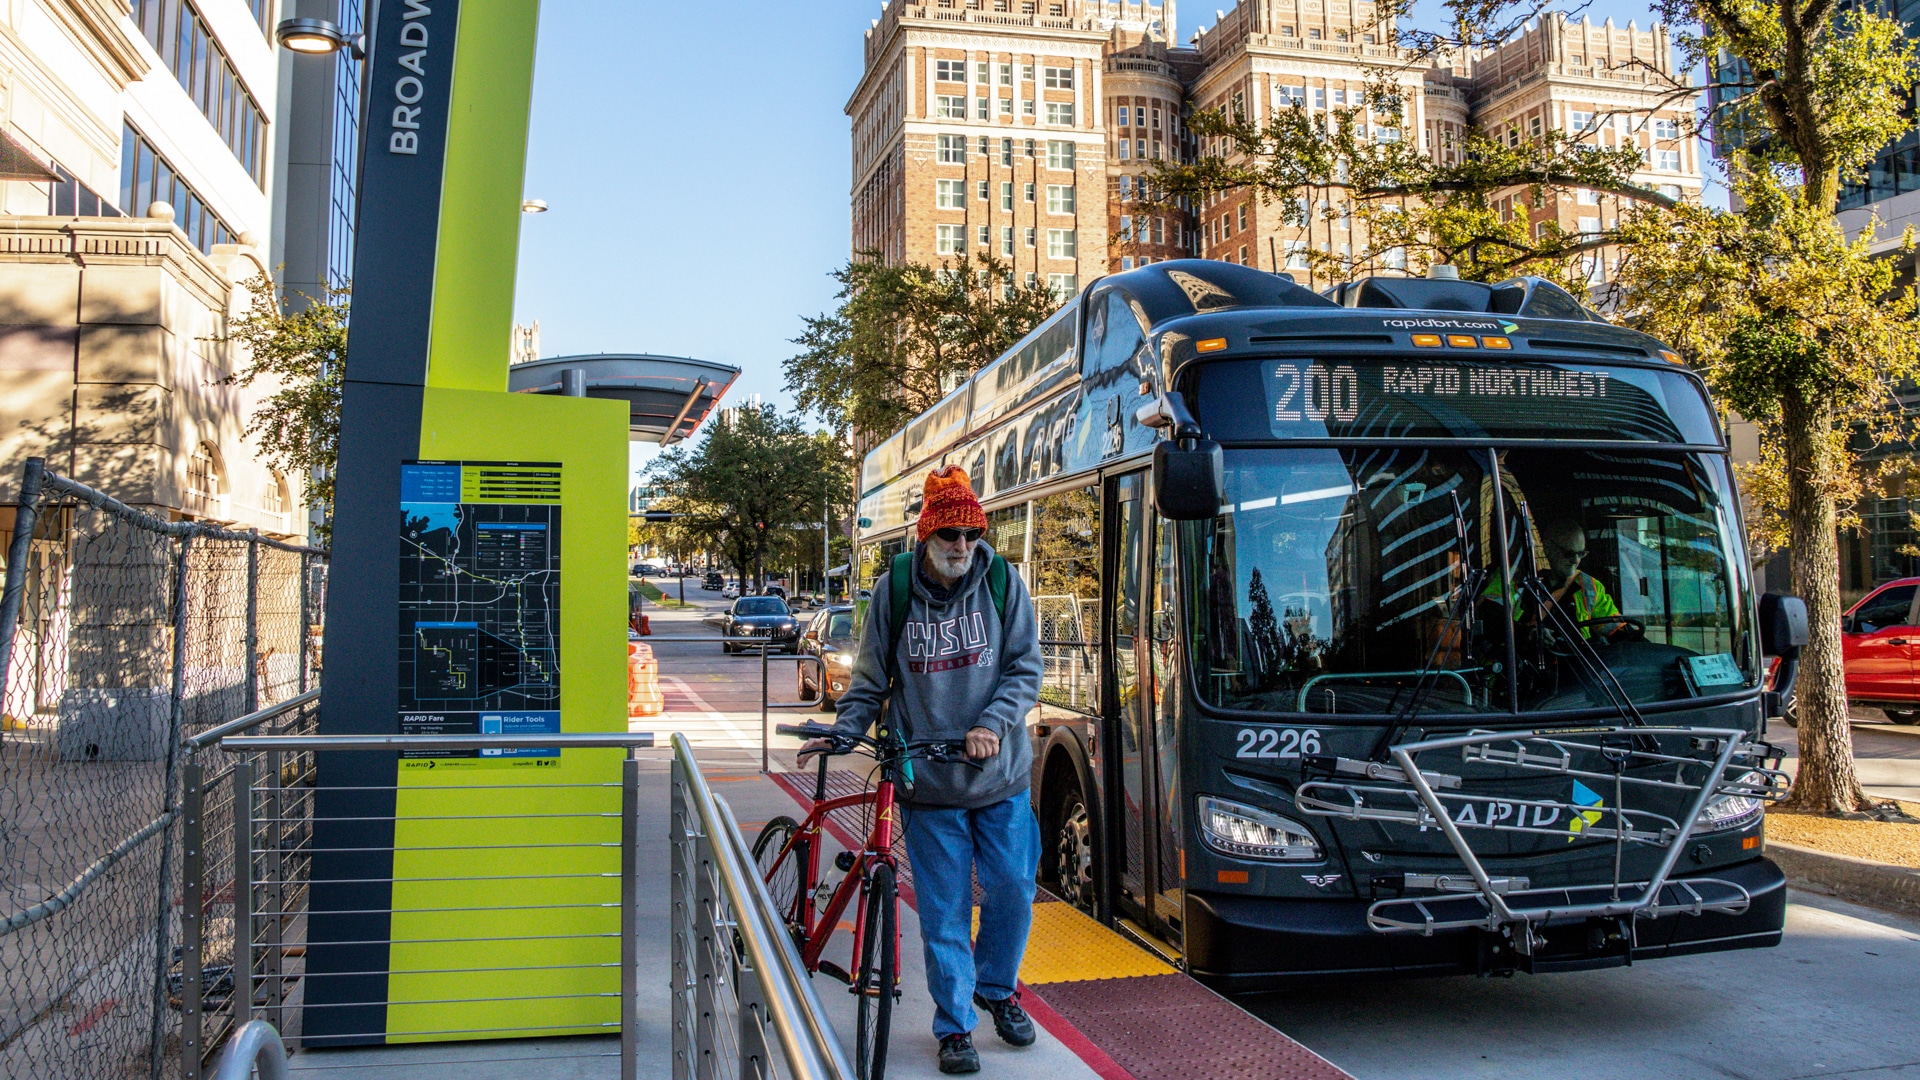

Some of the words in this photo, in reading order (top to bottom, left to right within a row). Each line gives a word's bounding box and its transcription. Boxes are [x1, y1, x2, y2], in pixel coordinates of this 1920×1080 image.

[1382, 318, 1498, 330] rapidbrt.com
[1275, 364, 1358, 421] 200
[1383, 366, 1460, 394] RAPID
[1469, 368, 1609, 397] NORTHWEST
[906, 611, 988, 658] WSU
[911, 655, 974, 672] COUGARS
[525, 715, 545, 723] Tools
[1236, 729, 1321, 758] 2226
